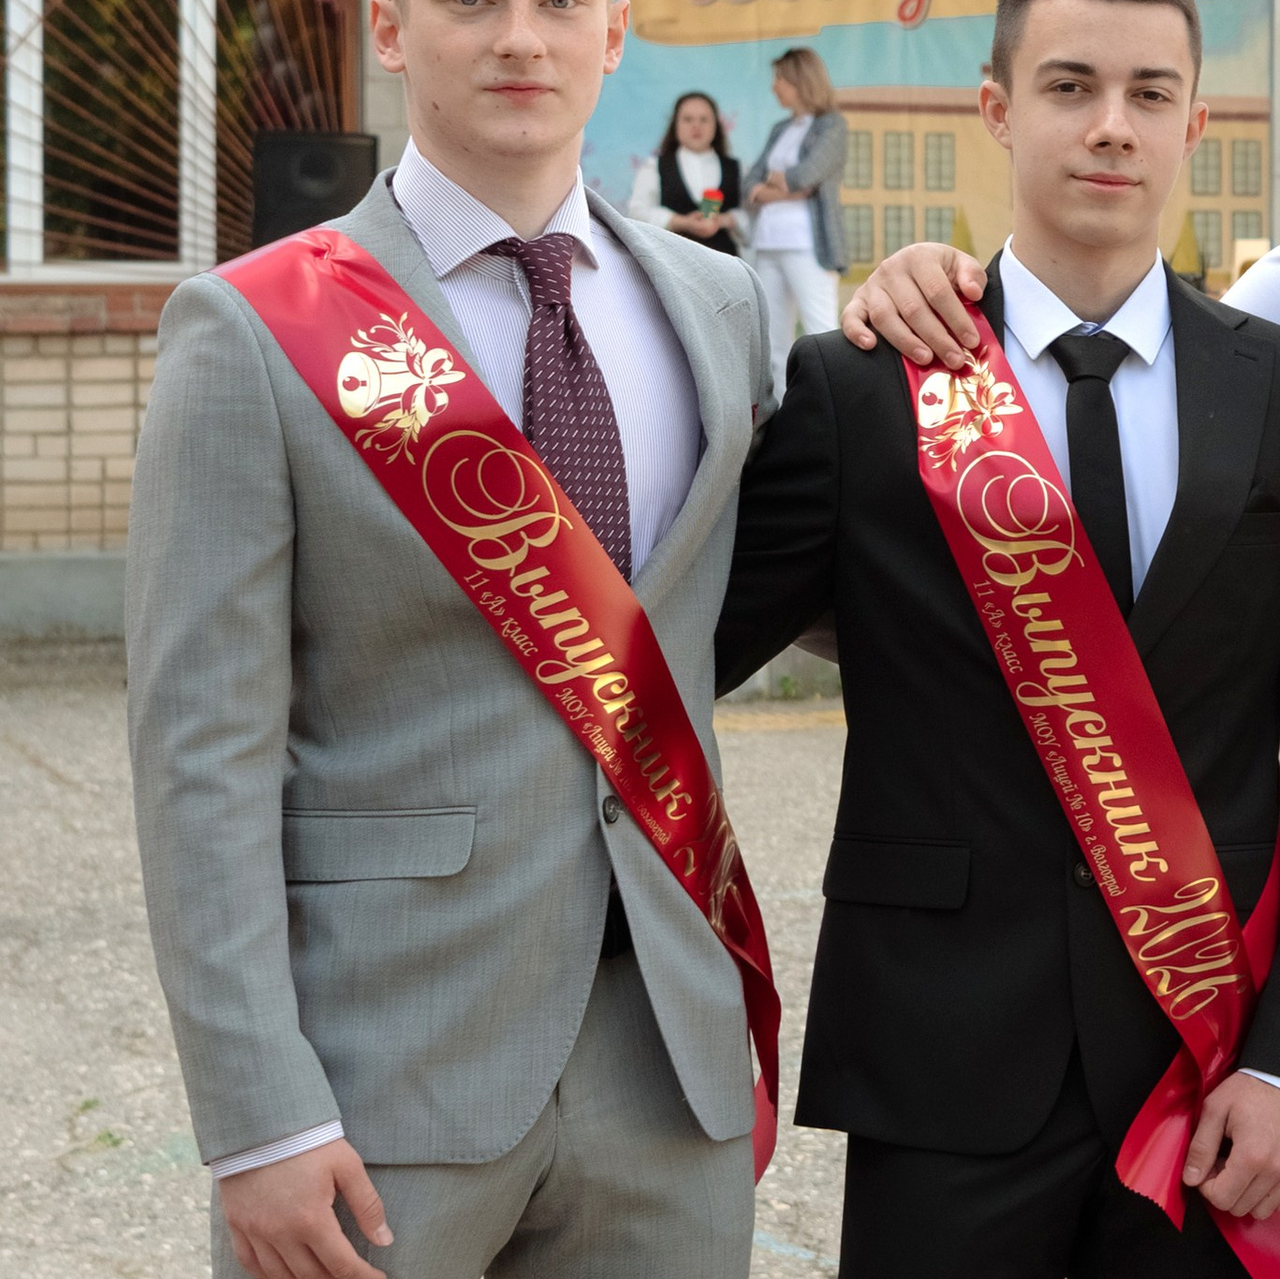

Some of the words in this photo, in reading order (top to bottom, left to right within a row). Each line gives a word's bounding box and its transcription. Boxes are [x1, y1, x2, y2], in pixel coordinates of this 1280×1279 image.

[422, 429, 692, 821] Выпускник
[463, 570, 484, 591] 11
[500, 617, 539, 657] класс
[973, 579, 995, 599] 11
[996, 632, 1024, 674] класс
[555, 687, 595, 722] МОУ
[581, 721, 617, 763] «Лицей
[956, 450, 1169, 882] Выпускник
[1119, 876, 1247, 1021] 2026
[1029, 712, 1062, 749] МОУ
[1045, 749, 1079, 793] «Лицей
[1089, 844, 1128, 898] Волгоград
